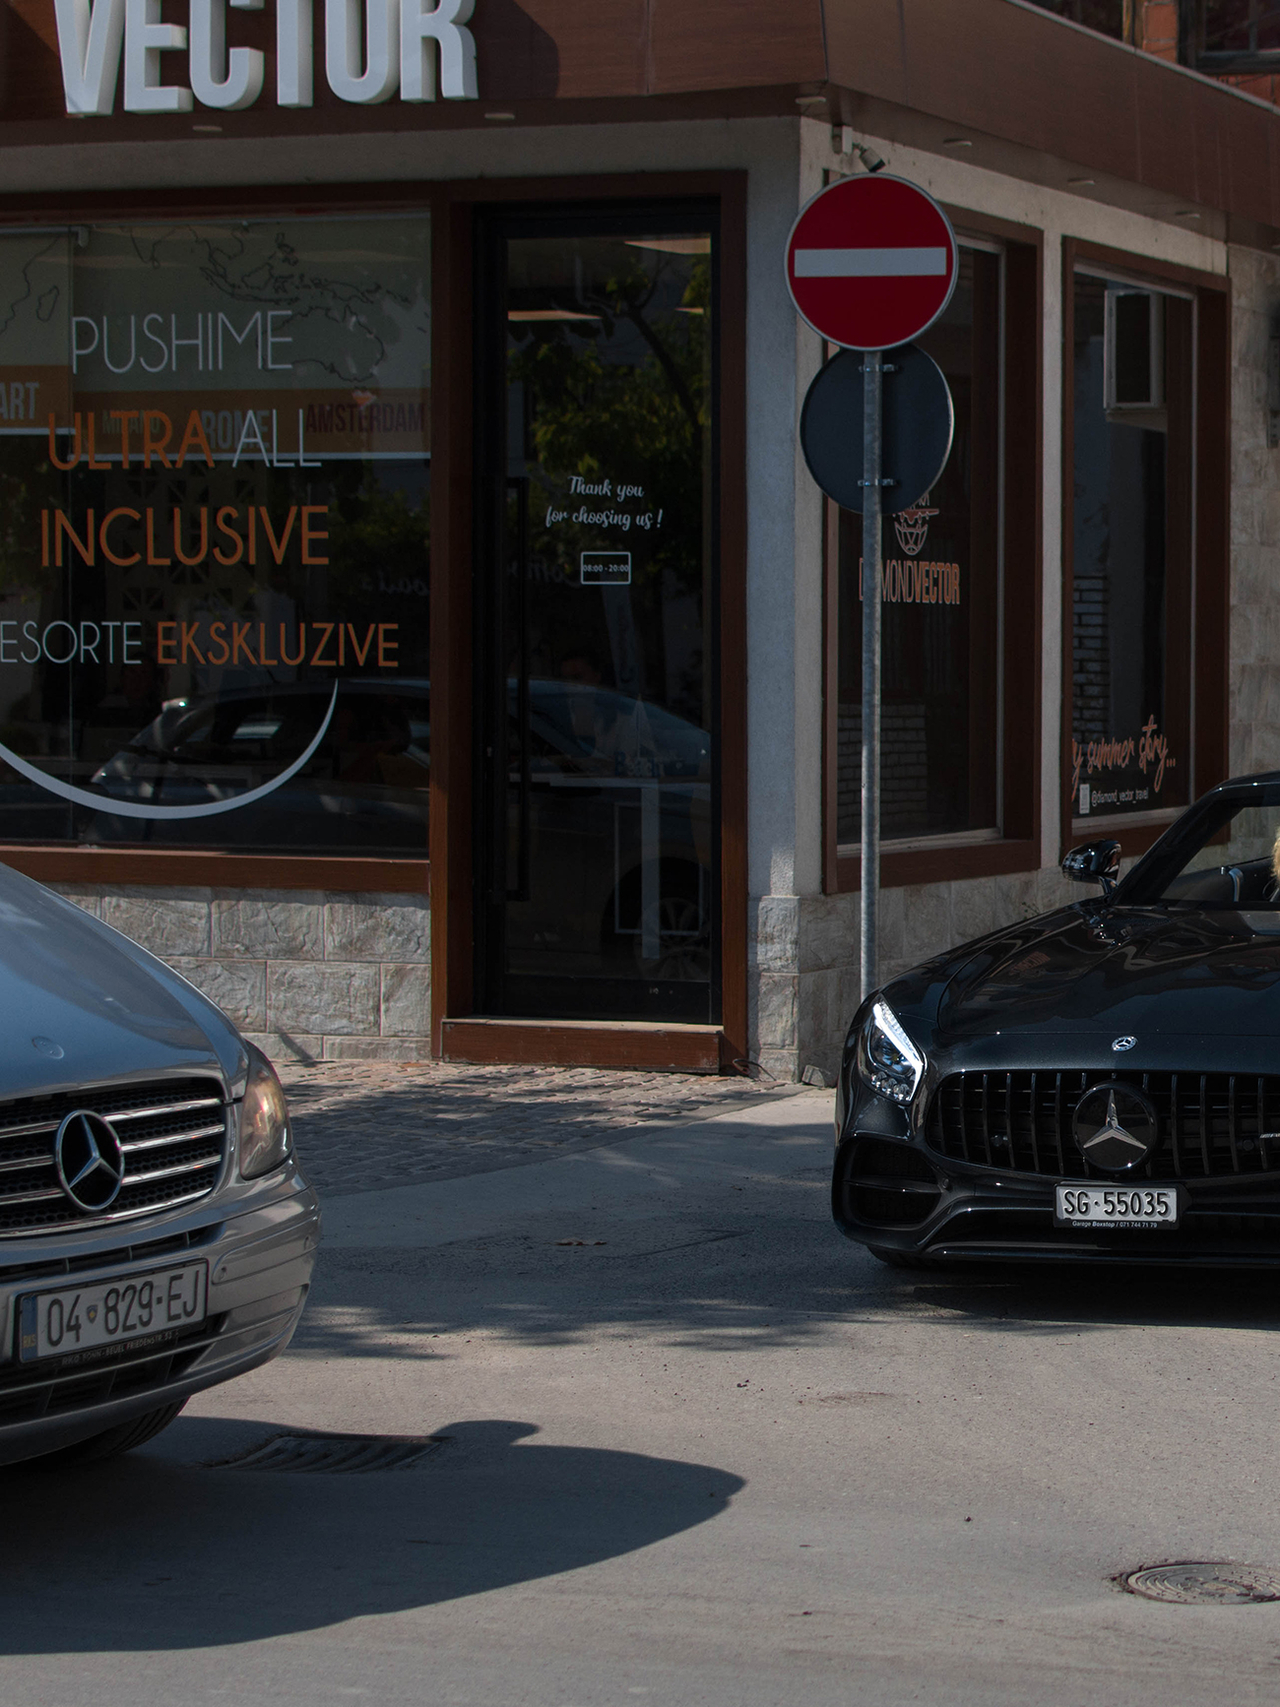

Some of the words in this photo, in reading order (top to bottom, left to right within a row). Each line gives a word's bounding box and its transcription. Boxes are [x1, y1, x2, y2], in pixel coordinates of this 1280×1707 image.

[54, 0, 479, 116] VECTOR
[72, 310, 294, 374] PUSHIME
[305, 402, 427, 434] AMSTERDAM
[48, 410, 216, 471] ULTRA
[232, 409, 322, 468] ALL
[567, 475, 613, 497] Thank
[617, 484, 645, 503] you
[41, 505, 330, 567] INCLUSIVE
[545, 505, 569, 529] for
[572, 505, 631, 531] choosing
[583, 564, 604, 573] 08:00
[609, 564, 630, 573] 20:00
[156, 621, 400, 667] EKSKLUZIVE
[1087, 737, 1135, 774] summer
[1072, 1220, 1091, 1228] Garage
[47, 1294, 82, 1347] 04
[104, 1270, 200, 1335] 829-EJ
